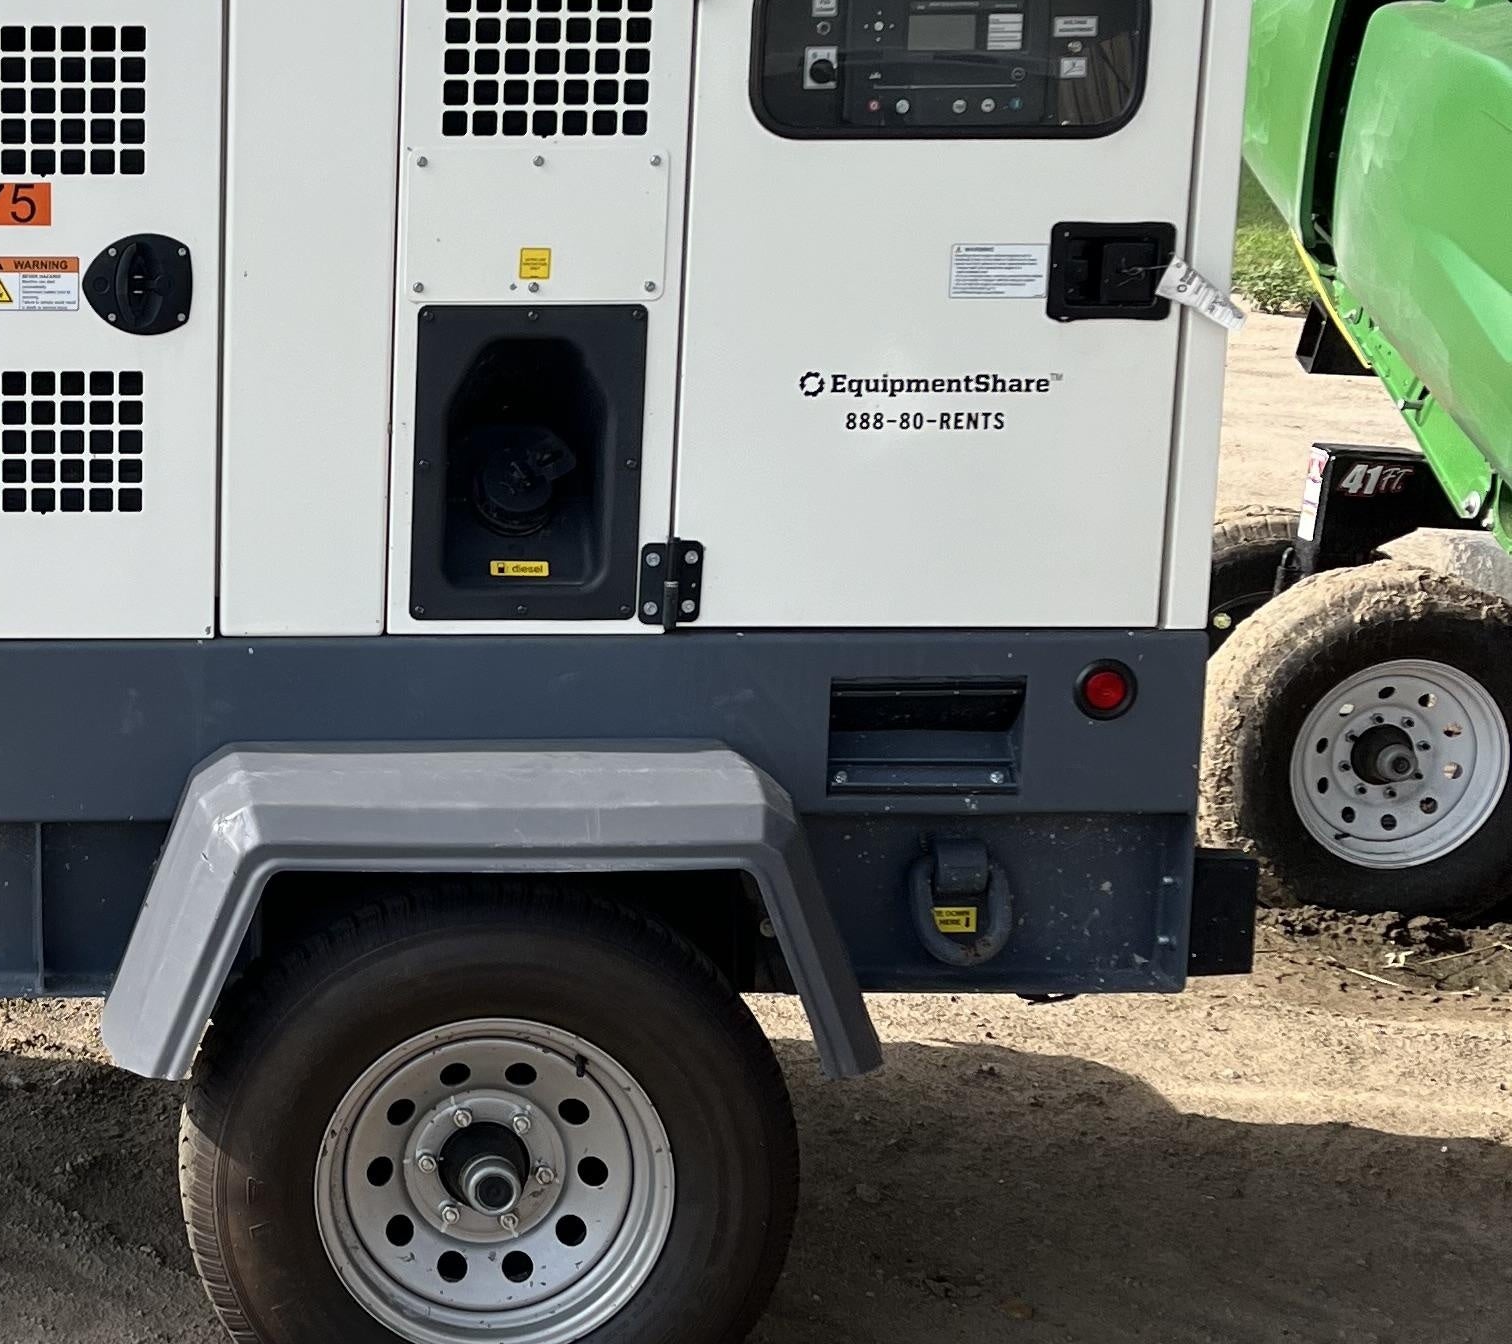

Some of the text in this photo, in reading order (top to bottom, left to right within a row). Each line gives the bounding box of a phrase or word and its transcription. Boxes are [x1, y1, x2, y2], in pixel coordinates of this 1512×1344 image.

[13, 259, 68, 270] WARNING
[845, 412, 1005, 430] 888-80-RENTS
[511, 564, 544, 574] diesel
